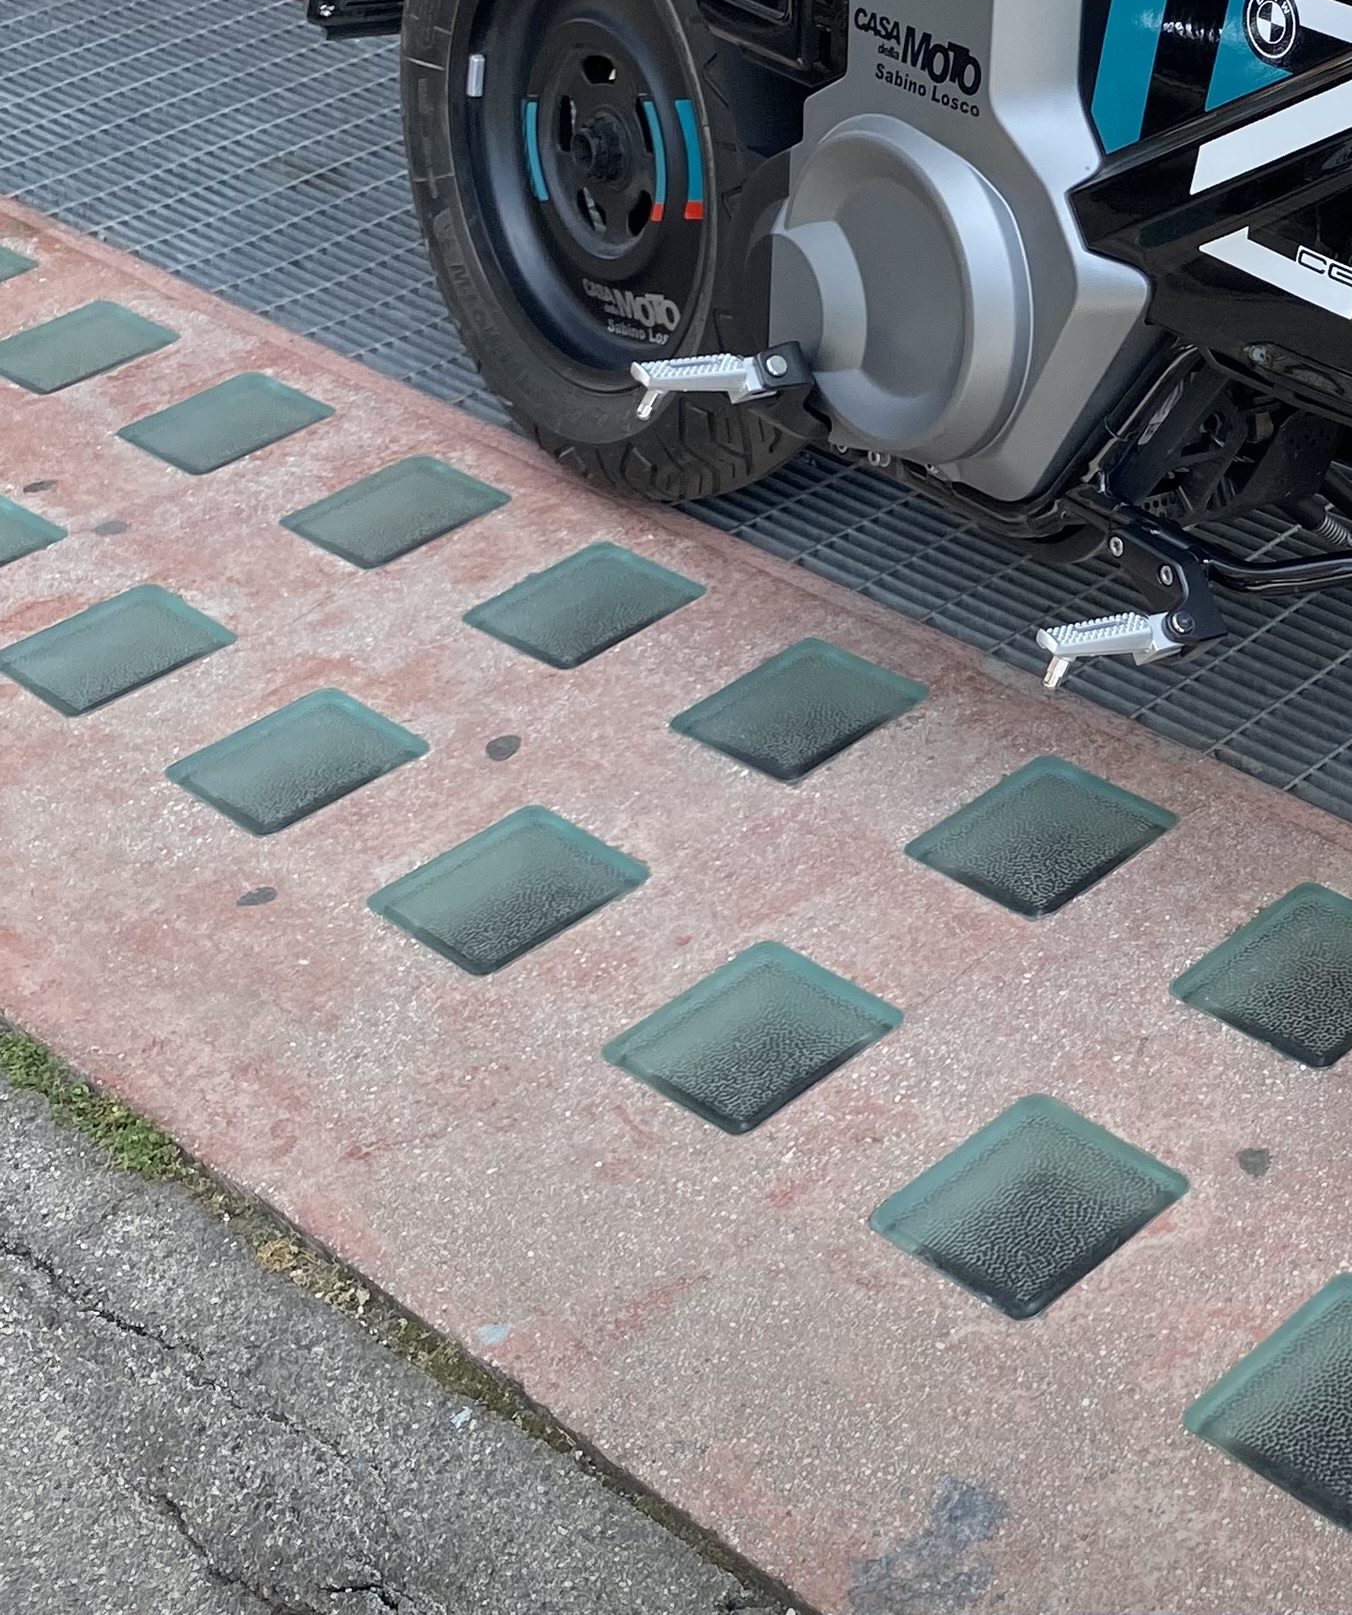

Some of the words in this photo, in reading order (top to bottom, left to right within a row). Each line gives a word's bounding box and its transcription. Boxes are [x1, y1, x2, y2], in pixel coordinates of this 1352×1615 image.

[853, 6, 901, 46] CASA
[875, 62, 927, 97] Sabino
[931, 85, 980, 117] Losco
